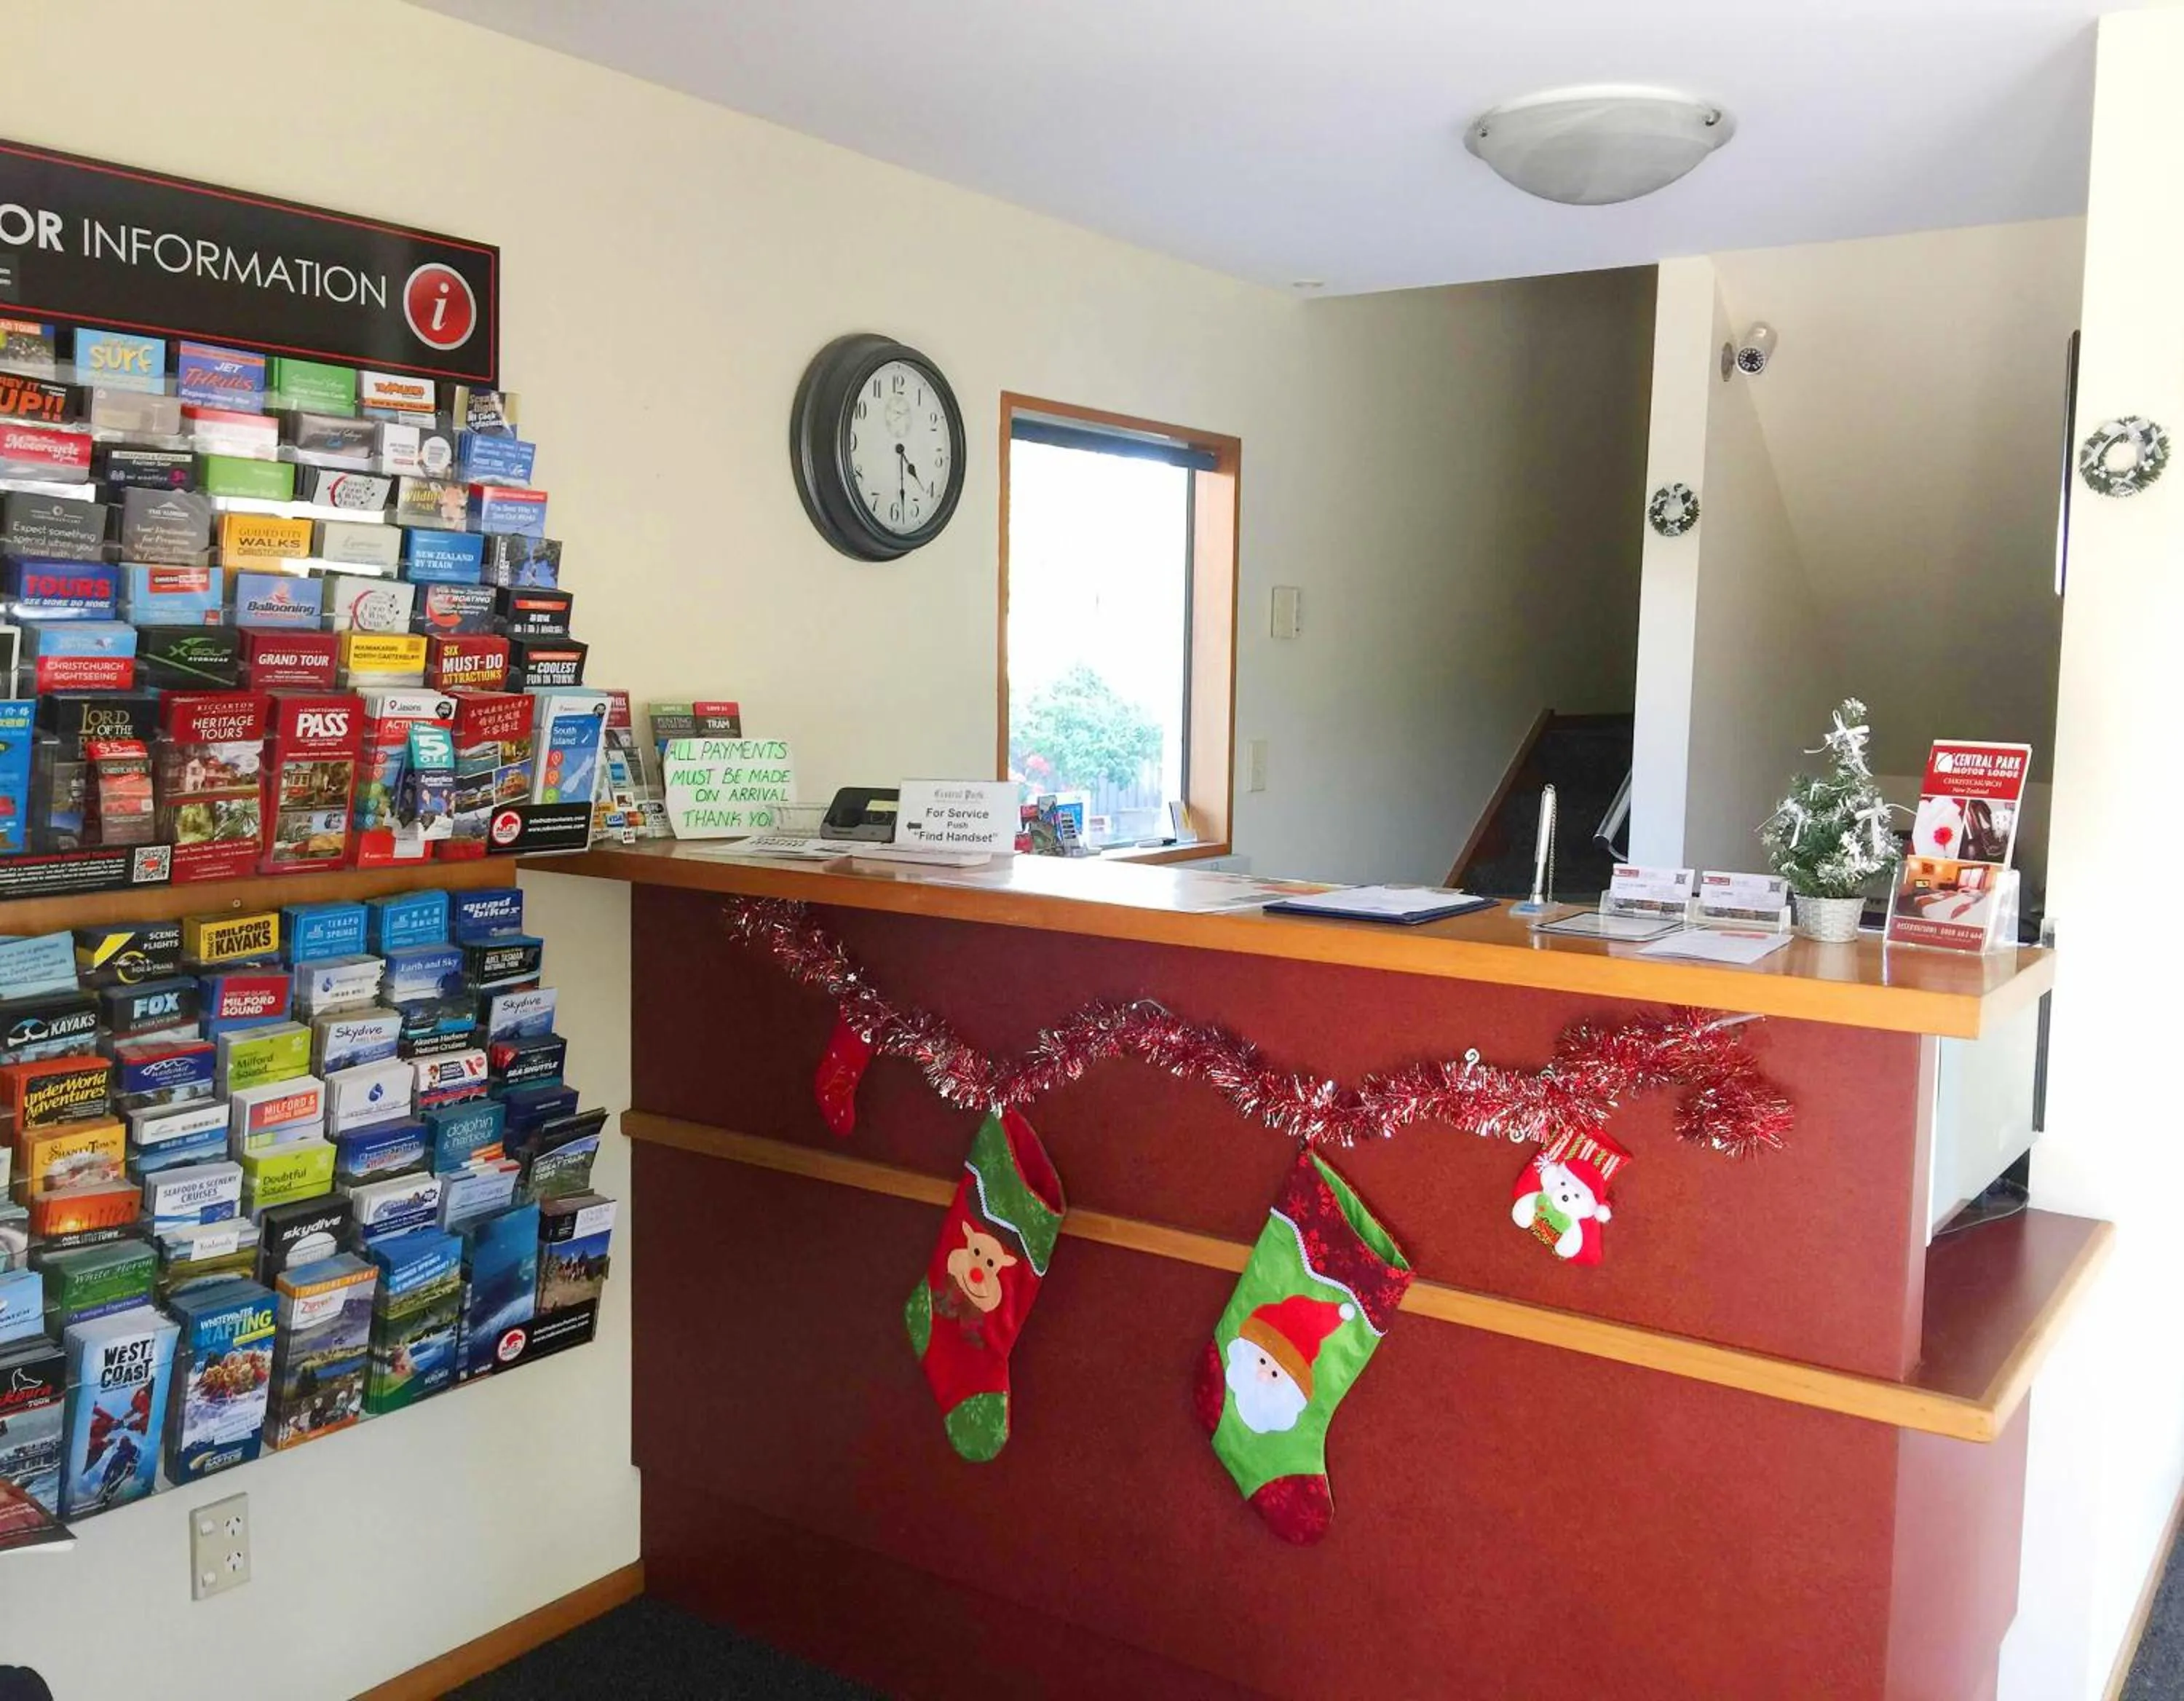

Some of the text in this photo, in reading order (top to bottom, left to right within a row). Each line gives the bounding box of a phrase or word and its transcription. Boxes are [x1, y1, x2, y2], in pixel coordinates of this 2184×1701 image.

[0, 203, 387, 309] OR INFORMATION
[214, 363, 243, 373] JET
[873, 379, 881, 399] 11
[893, 374, 905, 395] 12
[917, 387, 922, 406] 1
[852, 401, 867, 420] 10
[890, 502, 899, 522] 6
[13, 521, 96, 542] Expect something
[13, 534, 47, 546] special
[76, 540, 94, 552] you
[239, 537, 301, 548] WALKS
[416, 550, 474, 561] NEW ZEALAND
[414, 559, 454, 569] BY TRAIN
[25, 575, 111, 599] TOURS
[23, 598, 41, 606] SEE
[43, 599, 68, 607] MORE
[85, 599, 111, 608] MORE
[247, 601, 315, 615] Ballooning
[443, 644, 459, 656] SIX
[47, 660, 124, 671] CHRISTCHURCH
[258, 654, 329, 666] GRAND TOUR
[442, 653, 503, 674] MUST-DO
[537, 662, 577, 674] COOLEST
[53, 672, 117, 681] SIGHTSEEING
[442, 669, 502, 685] ATTRACTIONS
[526, 674, 542, 684] FUN
[197, 703, 255, 711] RICCARTON
[79, 703, 130, 735] LORD
[191, 714, 255, 729] HERITAGE
[296, 713, 349, 738] PASS
[705, 719, 730, 729] TRAM
[97, 724, 133, 736] OF THE
[200, 727, 244, 741] TOURS
[553, 726, 577, 735] South
[553, 735, 576, 746] Island
[668, 741, 788, 762] ALL PAYMENTS
[1953, 752, 2022, 770] CENTRAL PARK
[670, 767, 791, 786] MUST BE MADE
[1952, 767, 2019, 778] MOTOR LODGE
[695, 787, 790, 802] ON ARRIVAL
[682, 810, 742, 828] THANK
[925, 808, 989, 819] For Service
[947, 821, 969, 829] Push
[464, 896, 511, 914] quad
[473, 906, 521, 918] bikes
[215, 920, 271, 939] MILFORD
[328, 916, 360, 928] TEKAPO
[148, 929, 180, 940] SCENIC
[326, 928, 358, 939] SPRINGS
[143, 939, 179, 950] FLIGHTS
[215, 930, 272, 957] KAYAKS
[400, 957, 459, 973] Earth and Sky
[133, 992, 181, 1019] FOX
[222, 995, 276, 1006] MILFORD
[502, 996, 542, 1014] Skydive
[221, 1005, 263, 1017] SOUND
[50, 1013, 96, 1037] KAYAKS
[334, 1025, 384, 1046] Skydive
[440, 1033, 468, 1043] Harbour
[415, 1041, 467, 1055] Nature Cruises
[237, 1053, 274, 1068] Milford
[523, 1060, 559, 1074] SHUTTLE
[25, 1085, 106, 1121] Adventures
[264, 1096, 306, 1115] MILFORD
[446, 1116, 494, 1138] dolphin
[452, 1129, 494, 1148] harbour
[263, 1169, 307, 1186] Doubtful
[163, 1183, 198, 1199] SEAFOOD
[205, 1175, 237, 1188] SCENERY
[261, 1183, 293, 1197] Sound
[181, 1188, 218, 1203] CRUISES
[282, 1215, 343, 1241] skydive
[75, 1258, 154, 1284] White Heron
[200, 1306, 254, 1331] WHITEWATER
[201, 1309, 273, 1346] RAFTING
[104, 1339, 150, 1367] WEST
[100, 1358, 153, 1389] COAST
